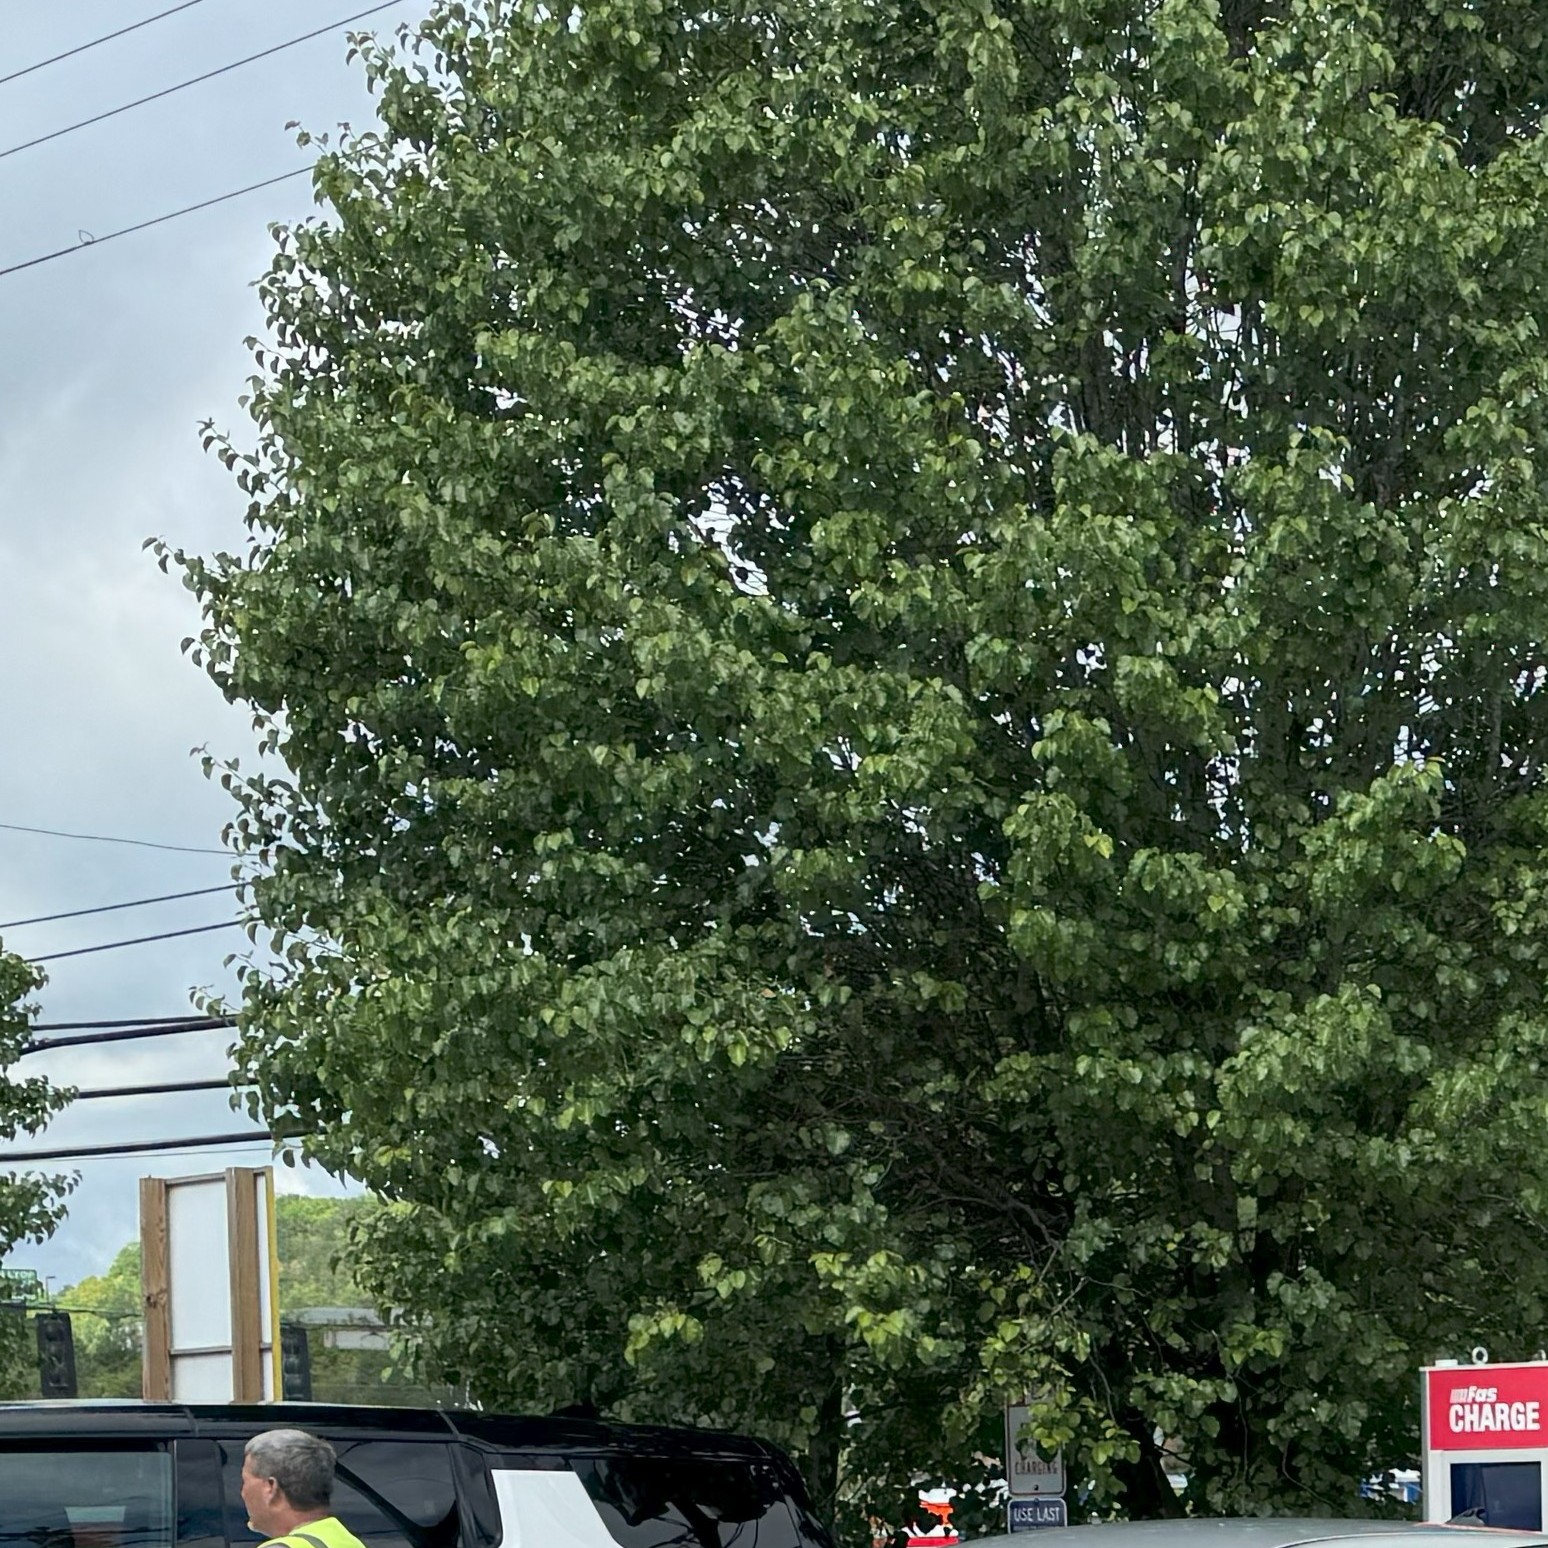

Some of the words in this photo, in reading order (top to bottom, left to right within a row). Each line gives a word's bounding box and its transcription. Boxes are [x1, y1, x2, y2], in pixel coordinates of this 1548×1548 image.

[1448, 1401, 1541, 1433] CHARGE
[1014, 1507, 1033, 1522] USE
[1036, 1506, 1060, 1522] LAST
